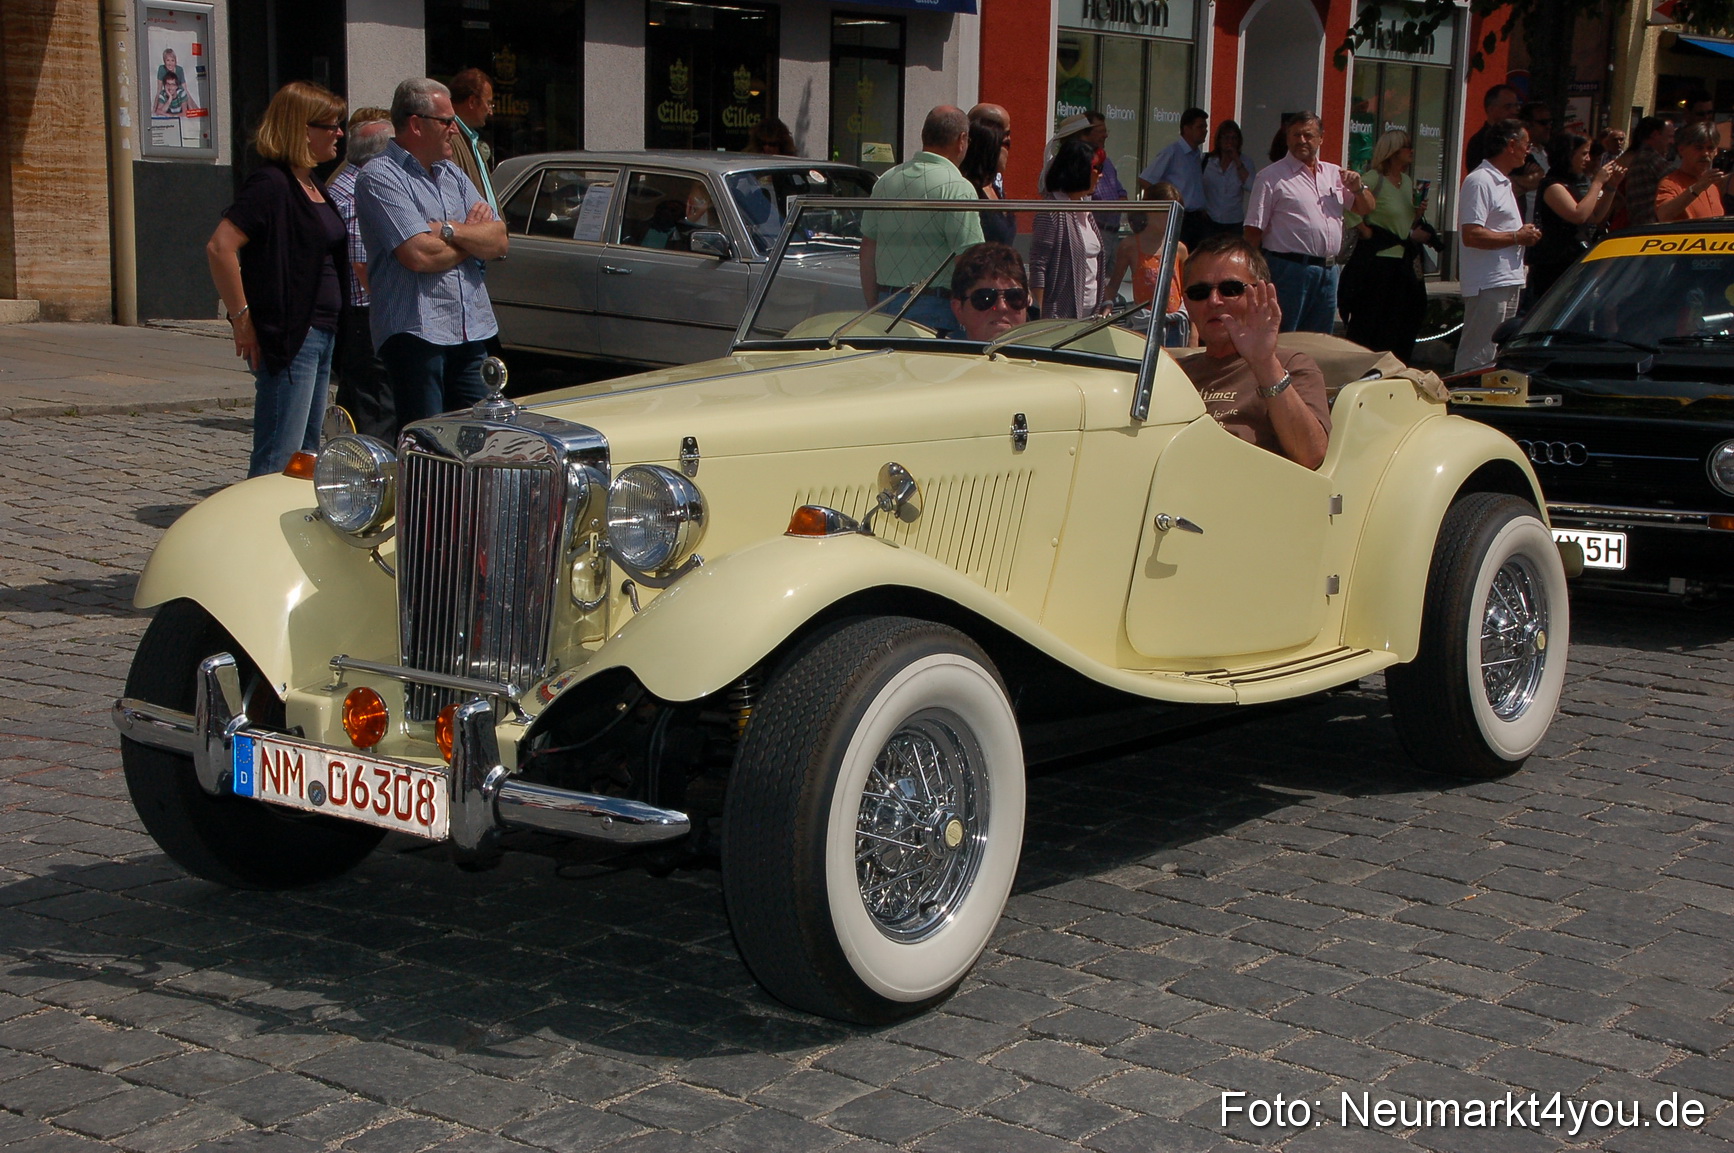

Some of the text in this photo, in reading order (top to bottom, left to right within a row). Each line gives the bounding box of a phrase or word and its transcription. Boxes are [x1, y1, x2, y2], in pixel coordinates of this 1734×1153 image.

[657, 100, 699, 125] Eilles
[721, 105, 761, 128] Eilles
[240, 771, 248, 784] D
[262, 746, 437, 827] NM 06308
